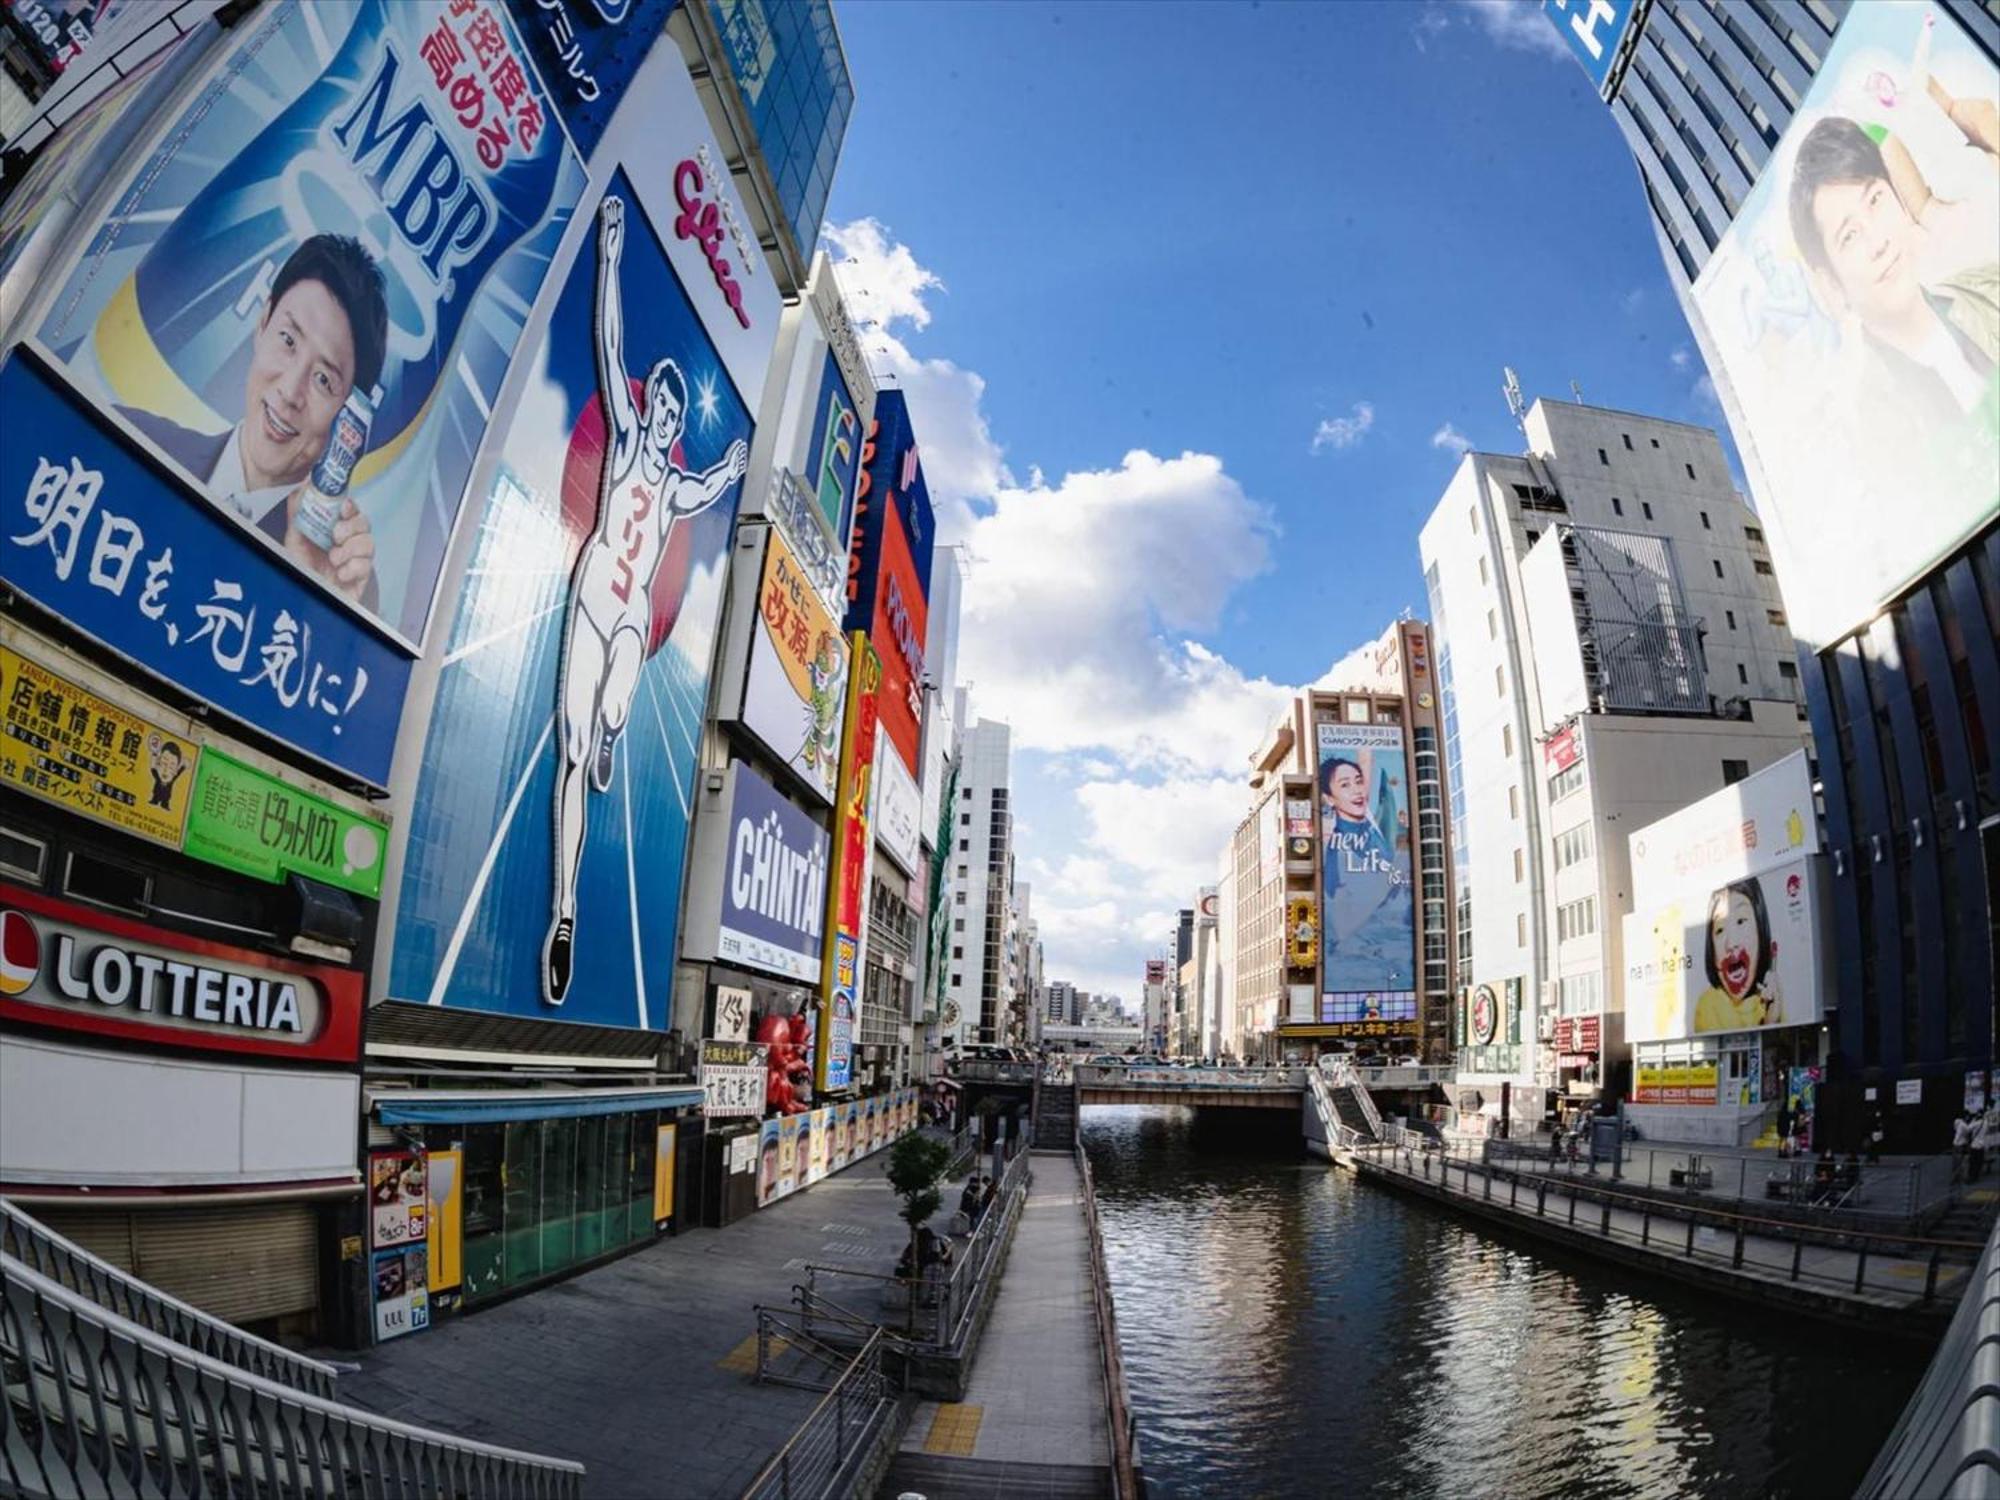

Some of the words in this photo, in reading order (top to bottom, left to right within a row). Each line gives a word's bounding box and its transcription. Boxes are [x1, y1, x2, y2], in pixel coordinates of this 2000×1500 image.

[419, 15, 512, 170] 高める
[332, 36, 491, 281] MBP
[610, 484, 655, 606] グリコ
[1330, 831, 1370, 850] new
[1347, 848, 1392, 872] Life
[57, 933, 302, 1033] LOTTERIA
